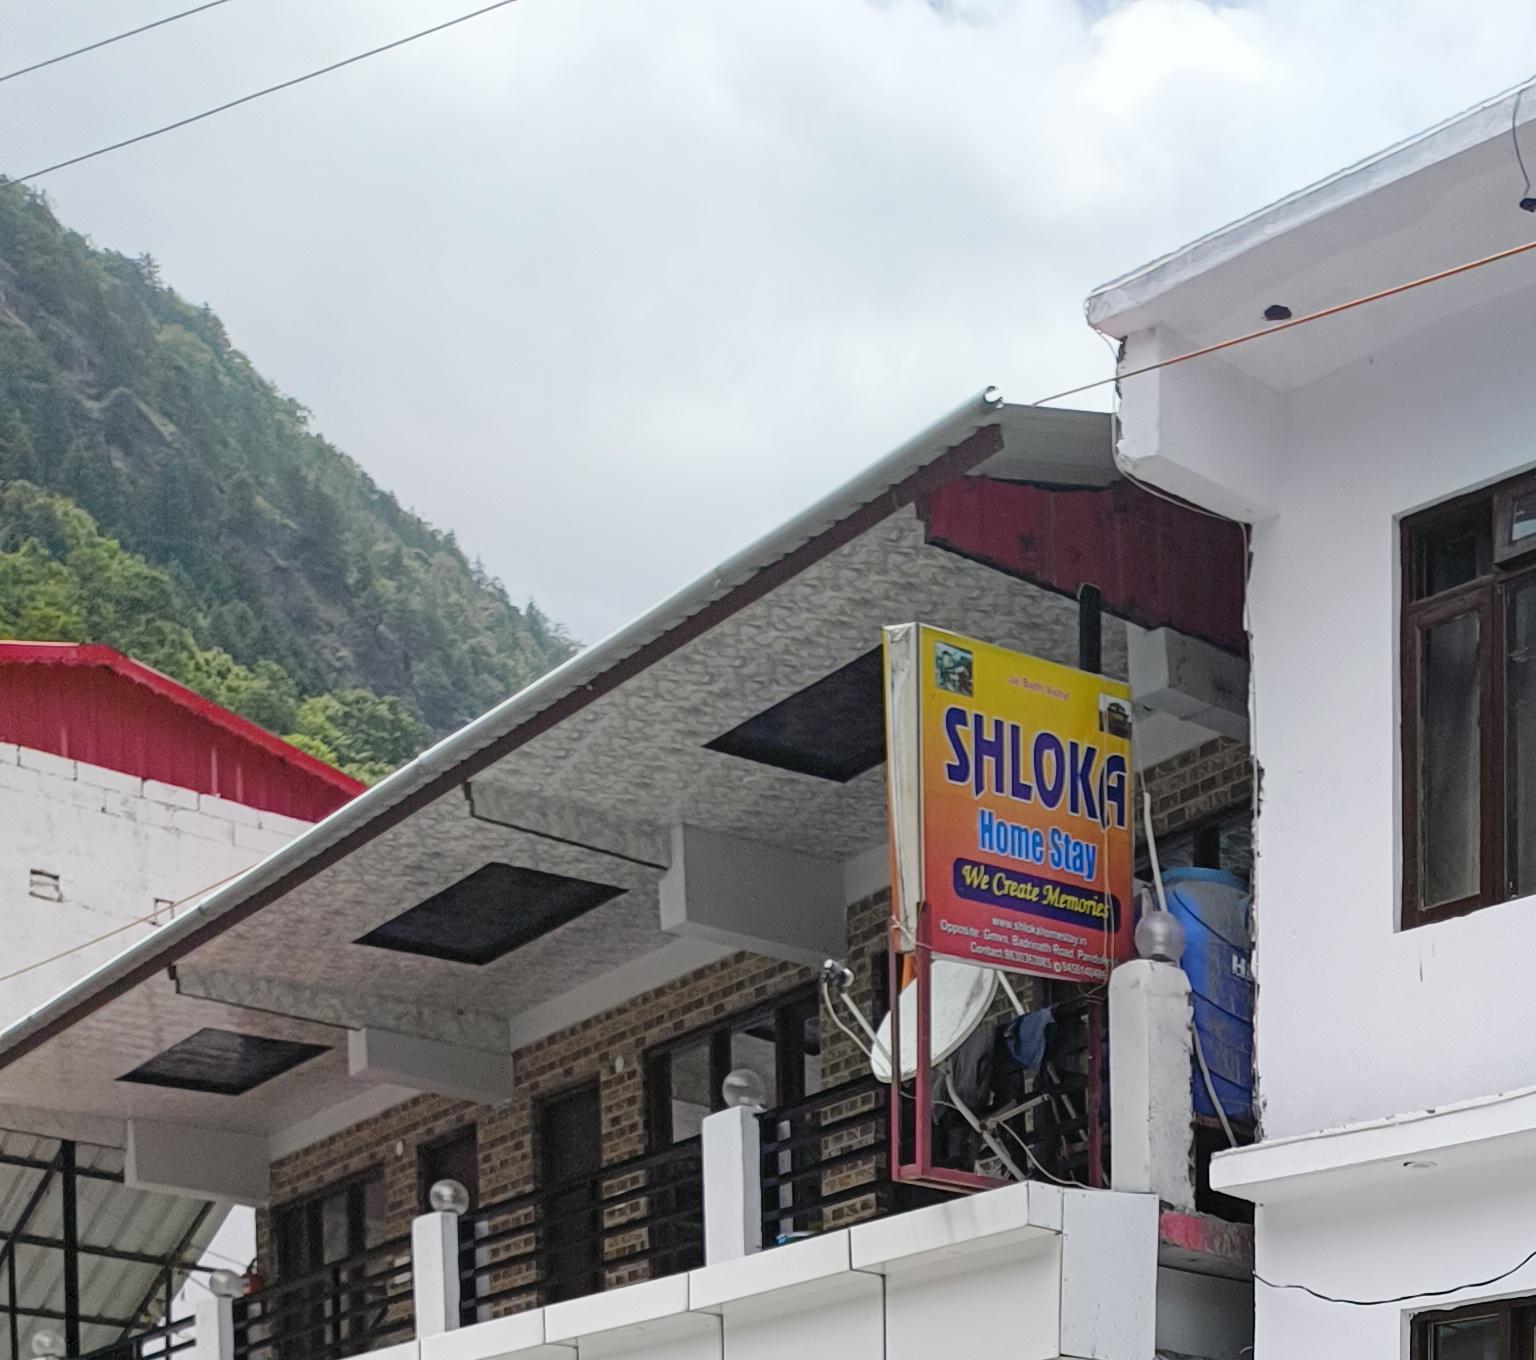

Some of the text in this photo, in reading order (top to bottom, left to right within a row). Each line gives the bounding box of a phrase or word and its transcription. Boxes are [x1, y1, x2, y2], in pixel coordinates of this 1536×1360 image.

[945, 706, 1128, 830] SHLOKA
[978, 808, 1098, 882] Home Stay
[961, 864, 1110, 920] We Create Memories
